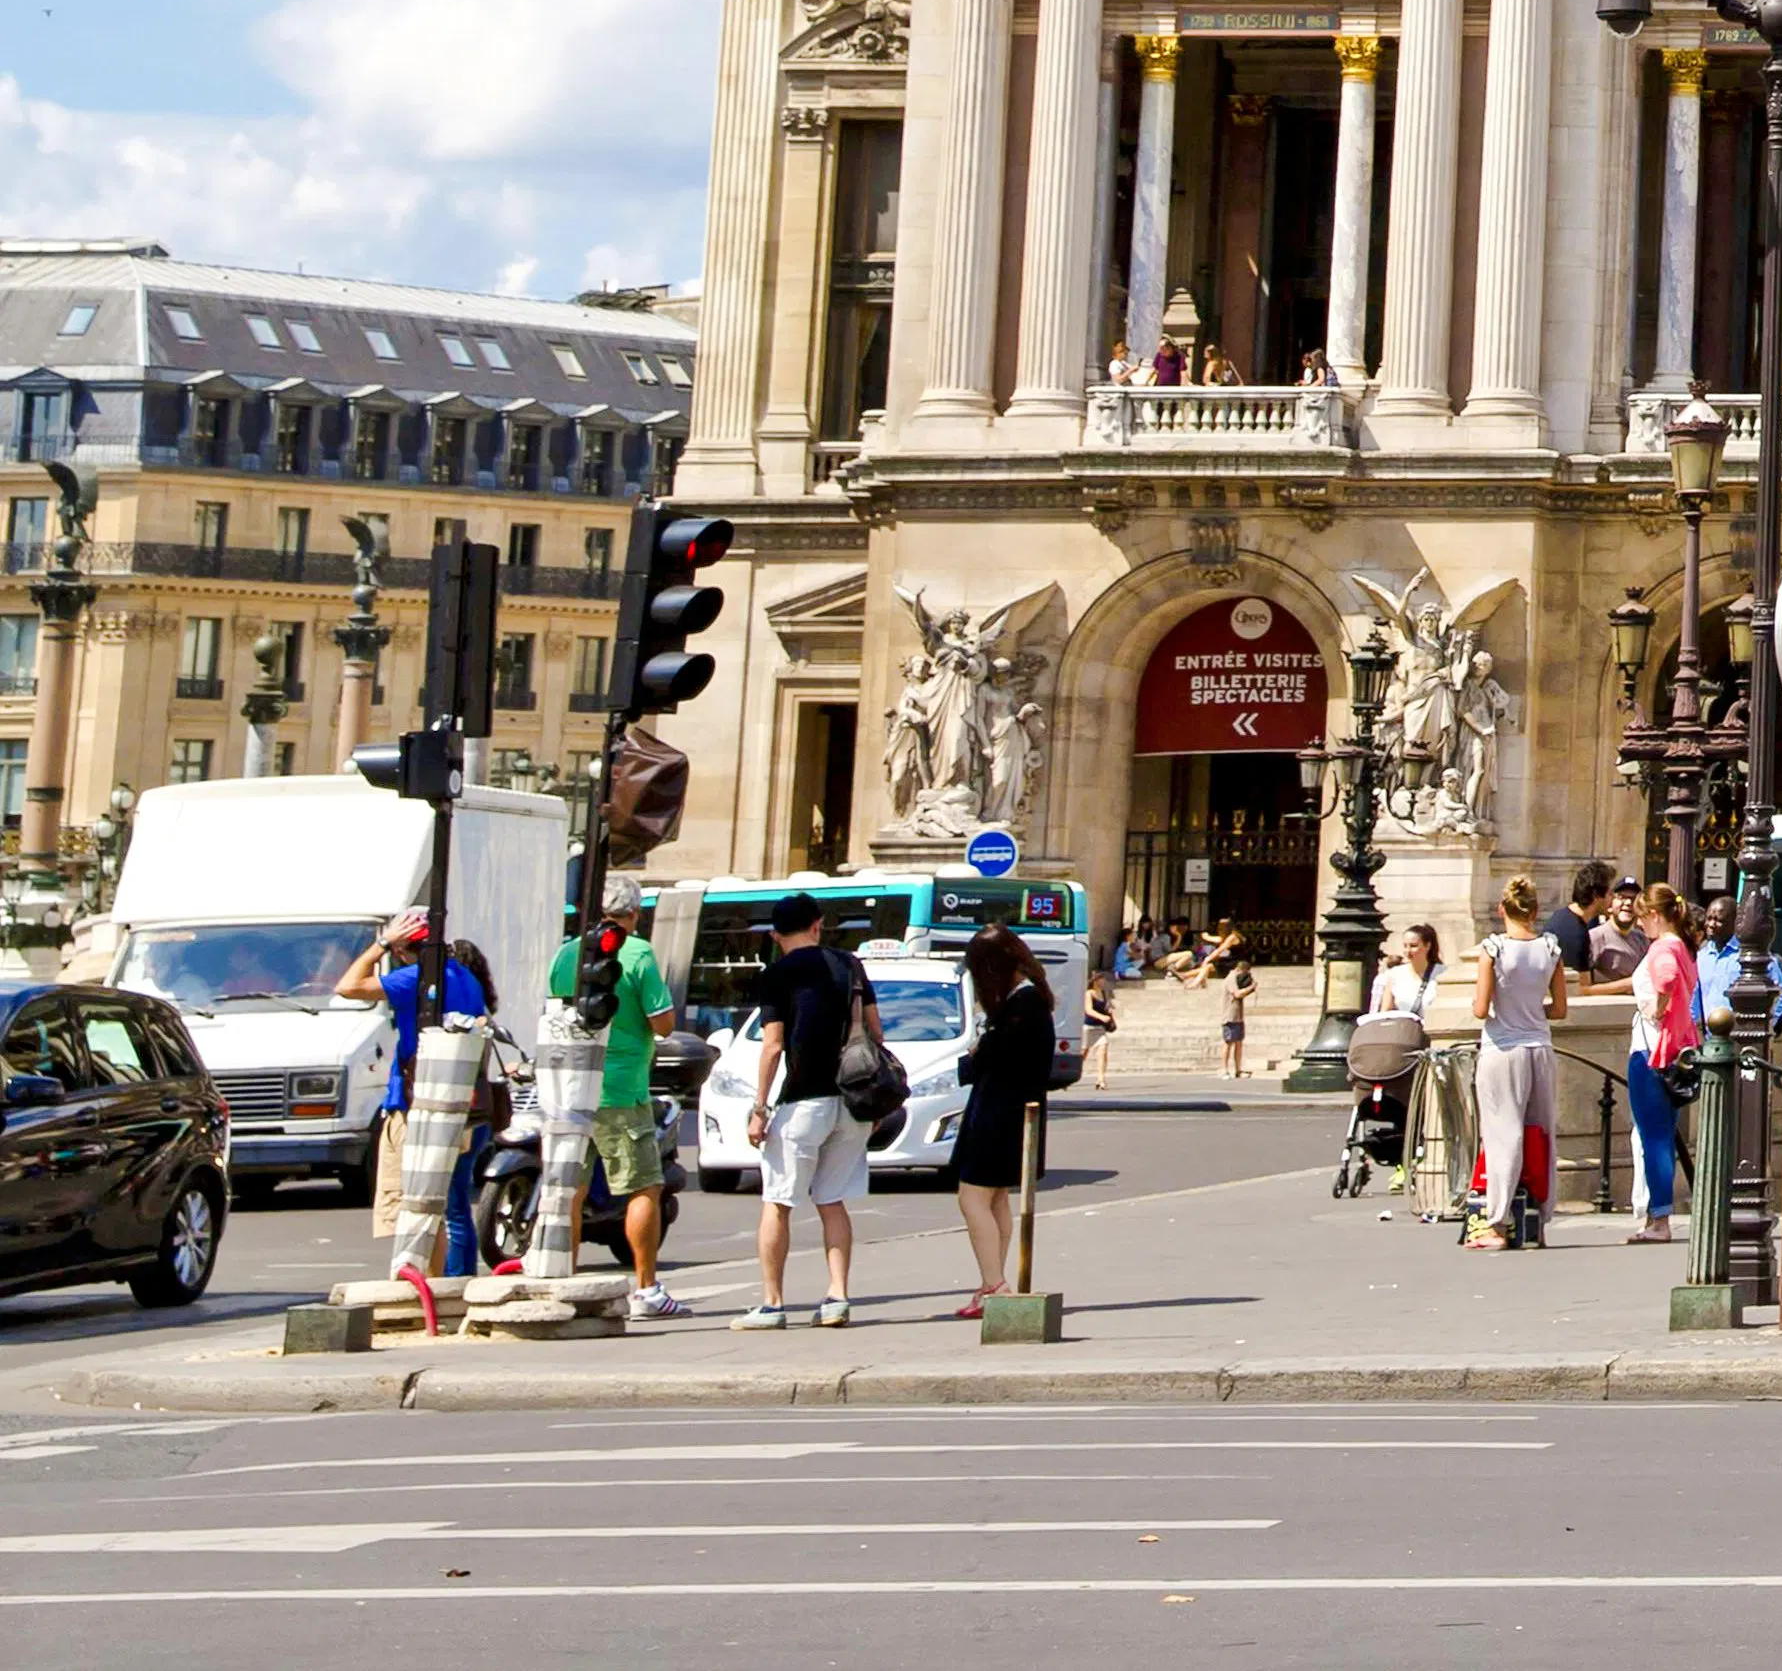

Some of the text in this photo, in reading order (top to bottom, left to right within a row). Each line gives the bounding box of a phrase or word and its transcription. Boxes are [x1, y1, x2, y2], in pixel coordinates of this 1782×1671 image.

[1224, 14, 1296, 29] ROSSINI
[1175, 650, 1324, 670] ENTRÉE VISITES
[1191, 675, 1307, 689] BILLETTERIE
[1191, 690, 1306, 704] SPECTACLES
[1031, 897, 1054, 915] 95
